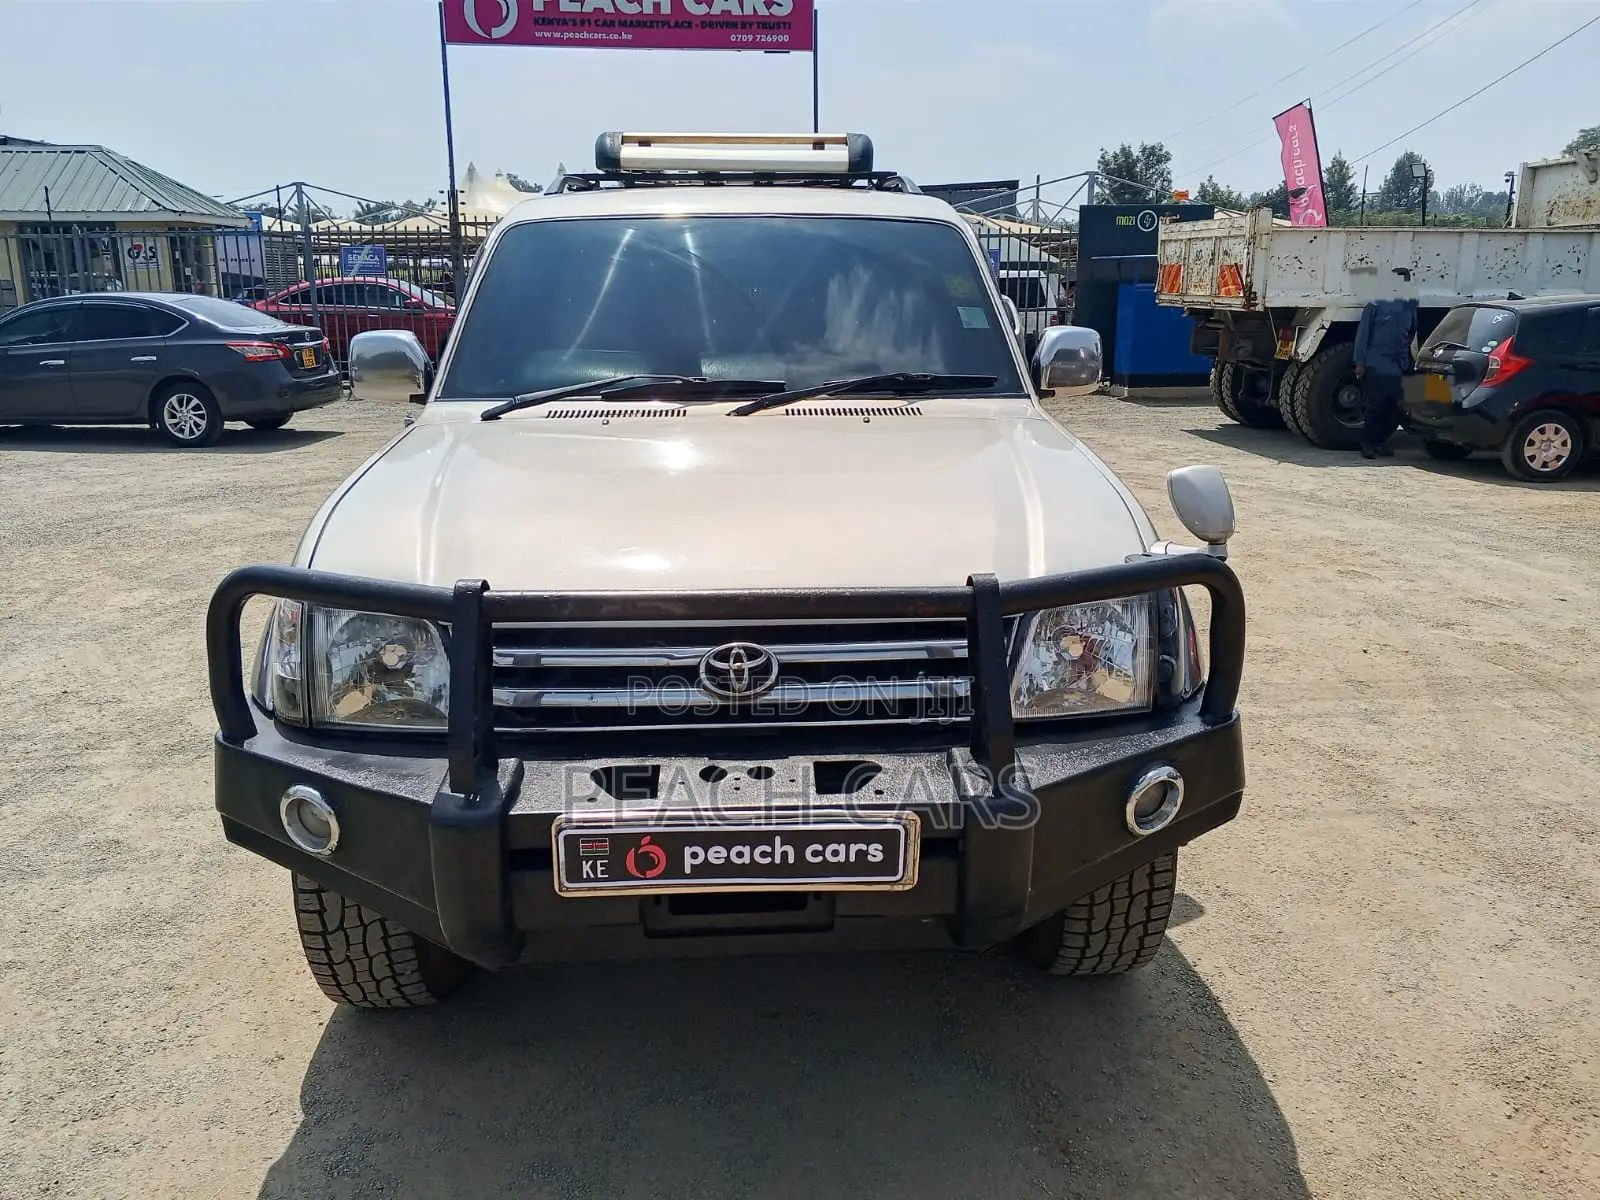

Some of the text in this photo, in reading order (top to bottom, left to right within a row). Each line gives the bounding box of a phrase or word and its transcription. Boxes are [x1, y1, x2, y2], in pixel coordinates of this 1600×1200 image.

[534, 17, 577, 27] KENYA'S
[594, 18, 616, 28] CAR
[618, 19, 693, 29] MARKETPLACE
[700, 20, 738, 29] DRIVEN
[740, 21, 754, 29] BY
[534, 30, 633, 40] www.peachcars.co.ke
[730, 34, 789, 43] 0709 726900
[683, 836, 884, 874] peach cars
[582, 860, 609, 879] KE
